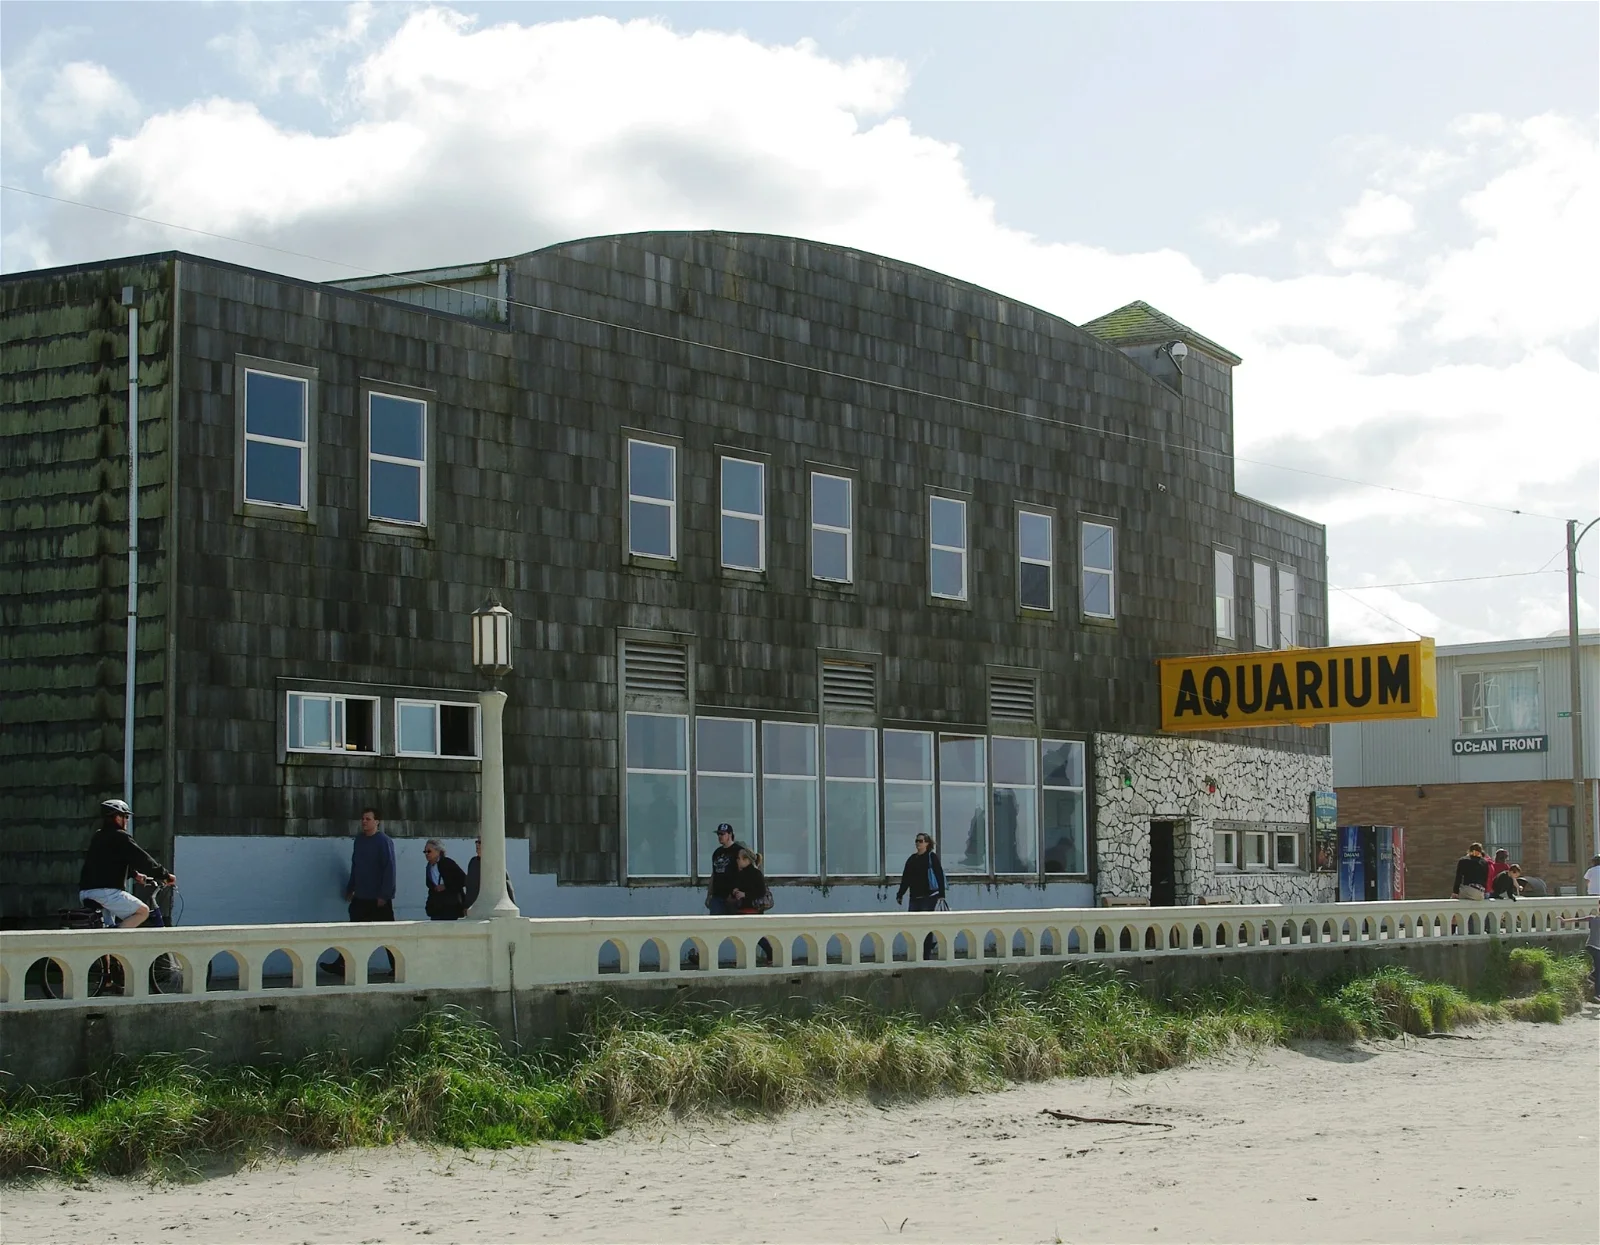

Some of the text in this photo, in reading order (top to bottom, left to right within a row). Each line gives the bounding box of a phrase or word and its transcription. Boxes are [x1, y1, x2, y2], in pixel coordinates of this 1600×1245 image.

[1174, 654, 1411, 719] AQUARIUM
[1454, 738, 1543, 753] OCEAN FRONT
